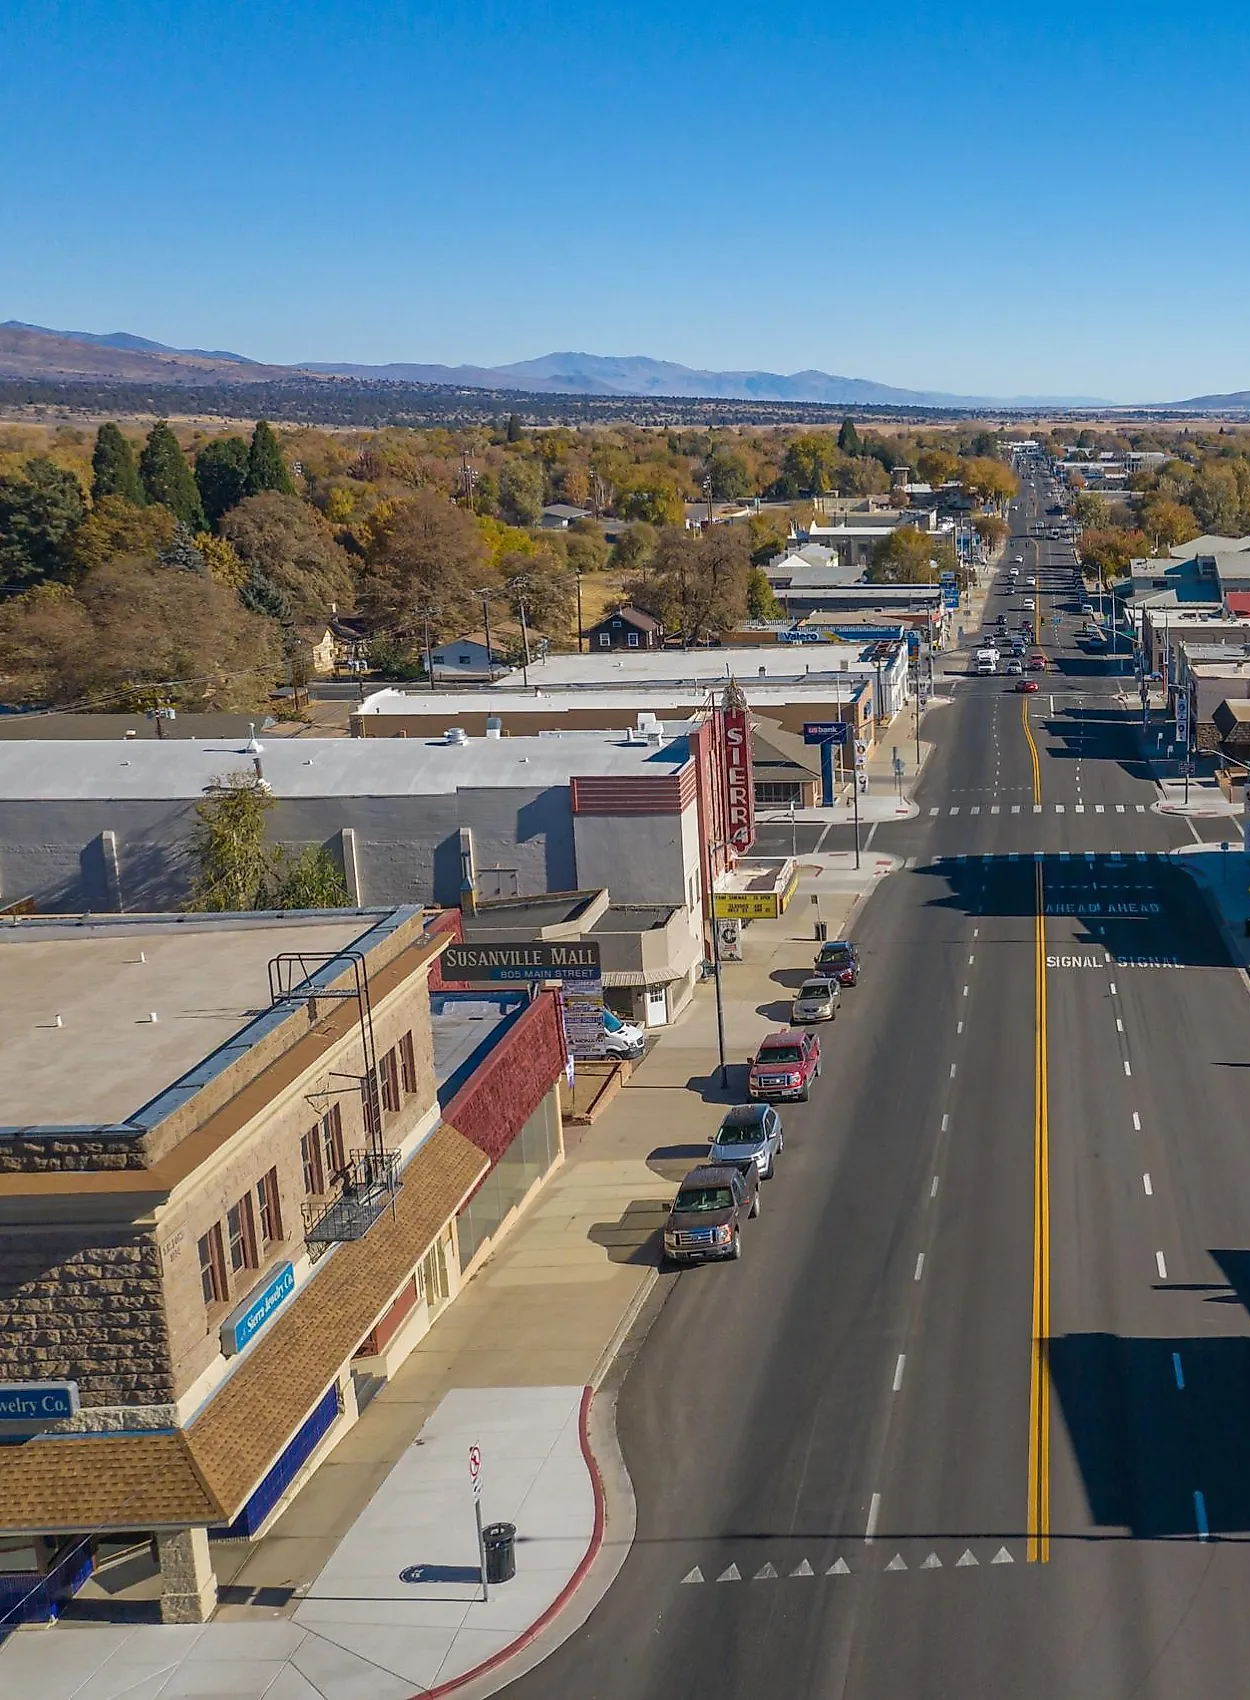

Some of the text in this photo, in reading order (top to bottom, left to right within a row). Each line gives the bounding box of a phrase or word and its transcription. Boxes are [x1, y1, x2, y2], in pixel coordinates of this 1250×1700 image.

[783, 631, 818, 641] Valero
[727, 727, 749, 844] SIERRA
[1045, 903, 1097, 913] AHEAD
[1108, 903, 1160, 913] AHEAD
[446, 948, 597, 967] SUSANVILLE MALL
[1046, 955, 1104, 968] SIGNAL
[1117, 955, 1185, 968] SIGNAL
[524, 969, 551, 979] MAIN
[555, 969, 594, 978] STREET
[41, 1395, 68, 1412] Co.
